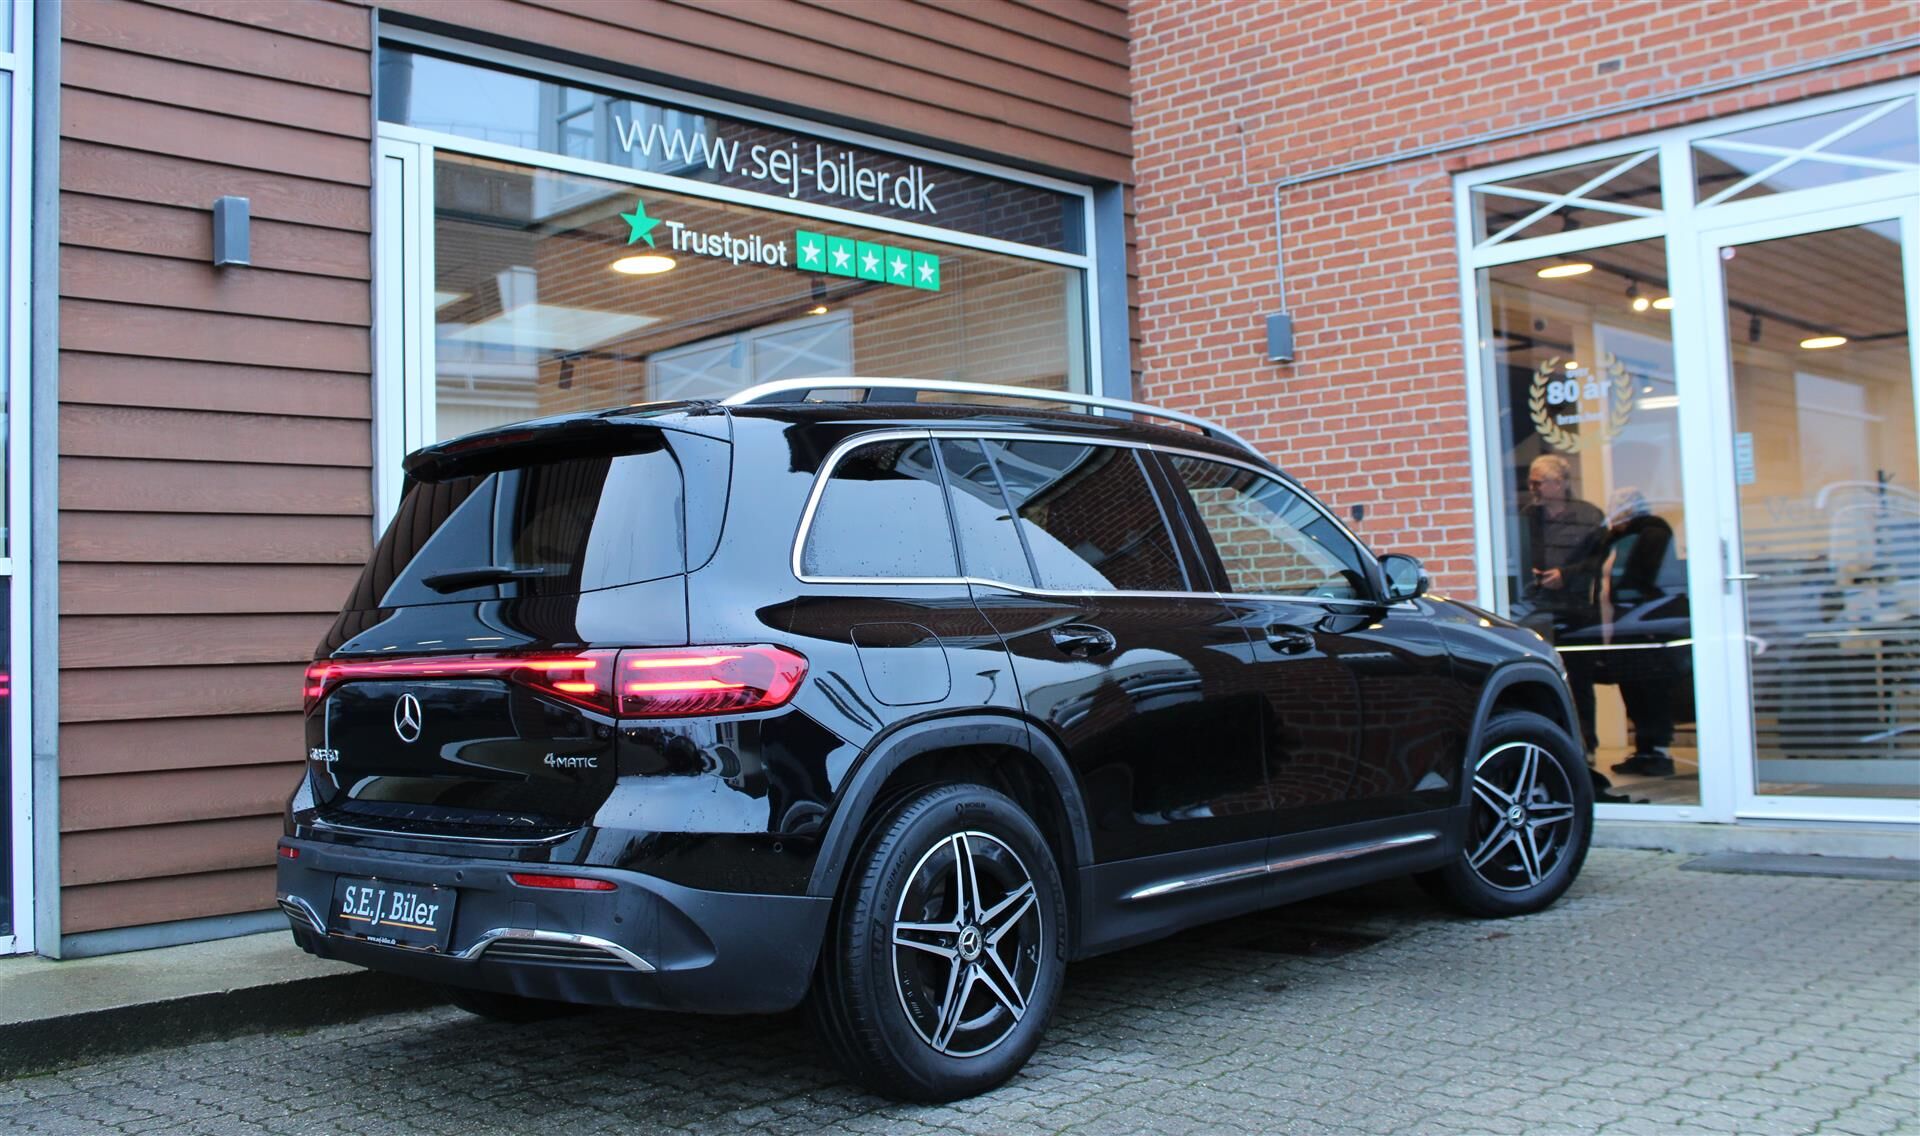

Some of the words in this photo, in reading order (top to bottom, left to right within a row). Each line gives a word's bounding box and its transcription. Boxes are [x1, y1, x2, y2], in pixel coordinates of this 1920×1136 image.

[615, 115, 937, 214] www.sej-biler.dk
[665, 220, 788, 267] Trustpilot
[1547, 380, 1580, 405] 80
[1583, 376, 1612, 401] år
[544, 753, 598, 768] 4MATIC
[343, 885, 385, 925] S.E.J.
[389, 891, 439, 926] Biler
